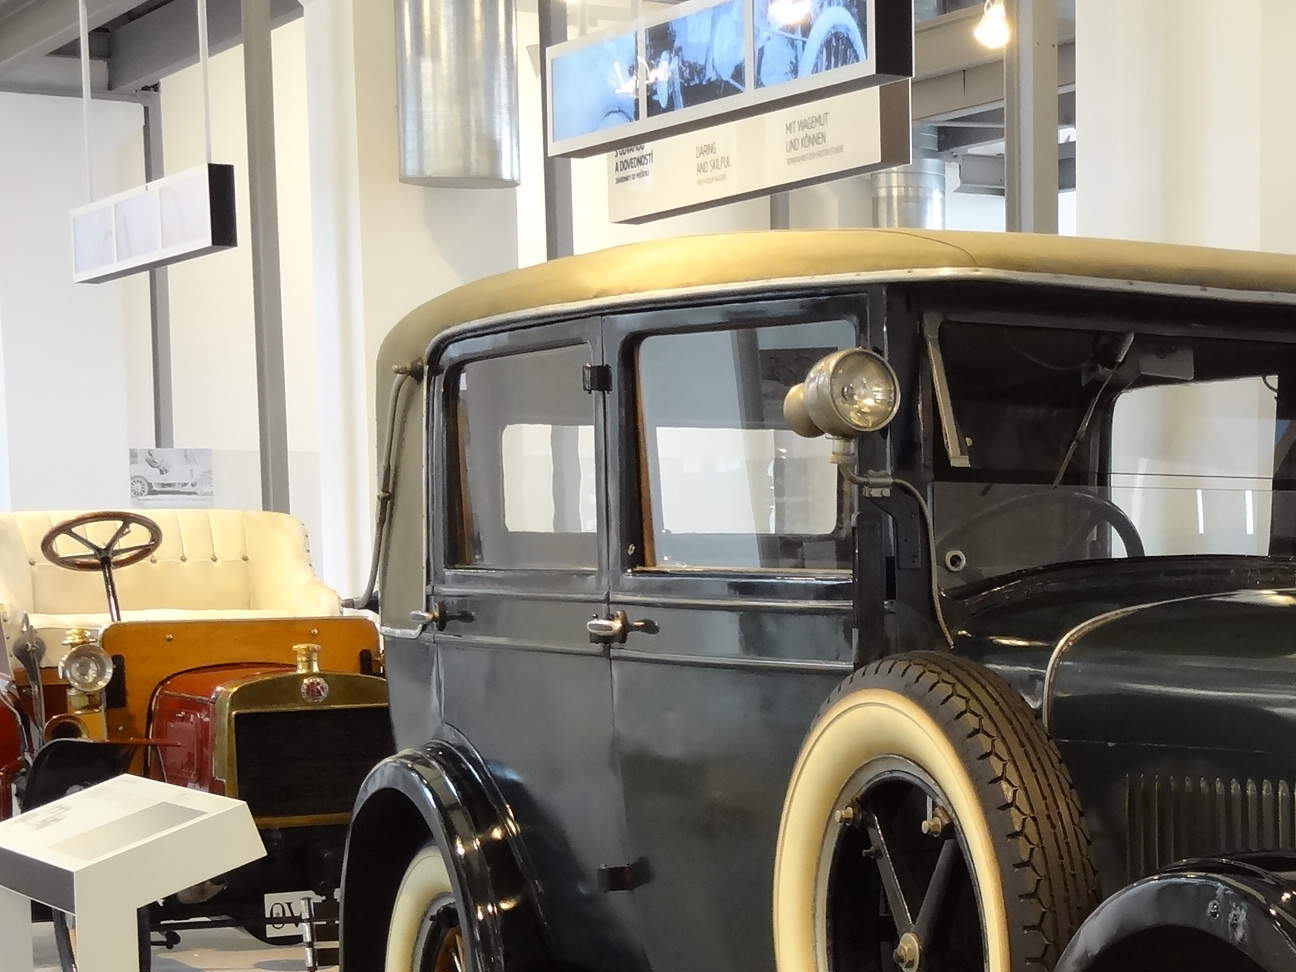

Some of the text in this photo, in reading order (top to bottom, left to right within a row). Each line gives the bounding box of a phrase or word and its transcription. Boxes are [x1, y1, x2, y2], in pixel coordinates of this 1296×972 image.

[785, 112, 829, 135] MIT WAGEMUT
[696, 142, 716, 159] DARING
[785, 138, 800, 153] UND
[614, 162, 620, 173] A
[697, 161, 709, 174] AND
